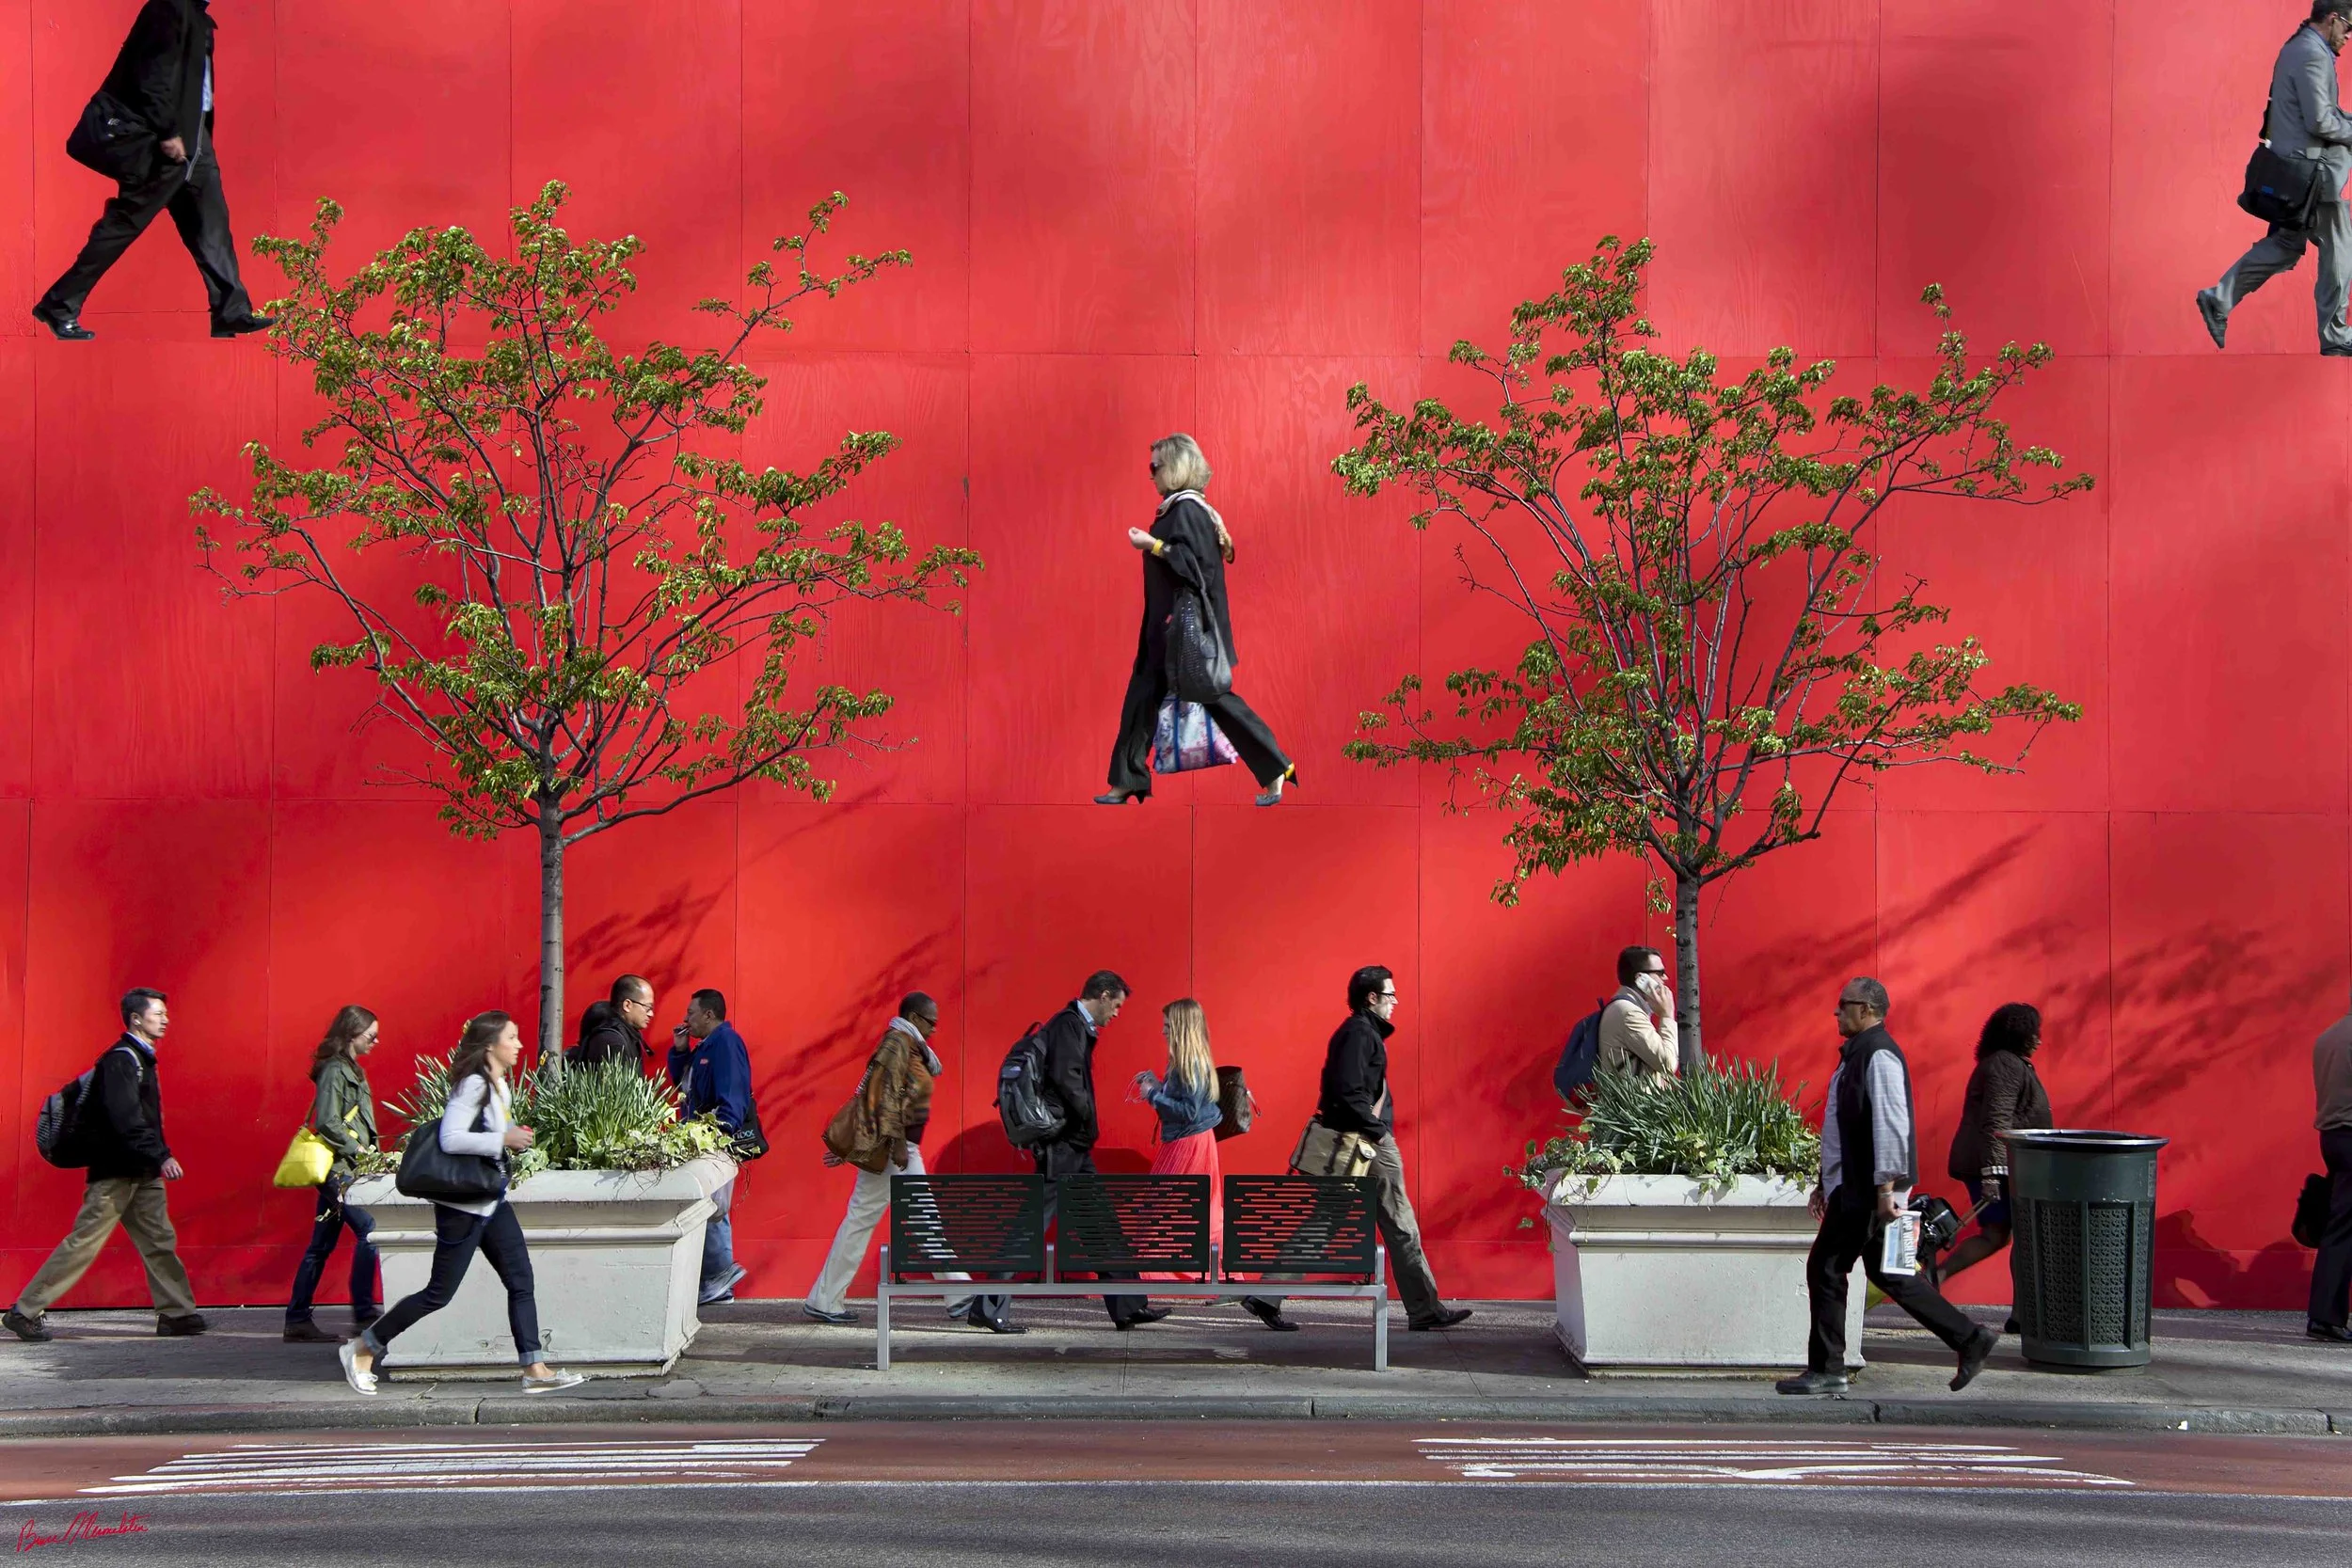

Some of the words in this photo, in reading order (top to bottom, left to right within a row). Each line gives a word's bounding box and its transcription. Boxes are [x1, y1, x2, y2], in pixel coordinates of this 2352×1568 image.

[1901, 1215, 1914, 1230] APP
[1902, 1230, 1915, 1251] WISH
[1905, 1251, 1916, 1268] LIST
